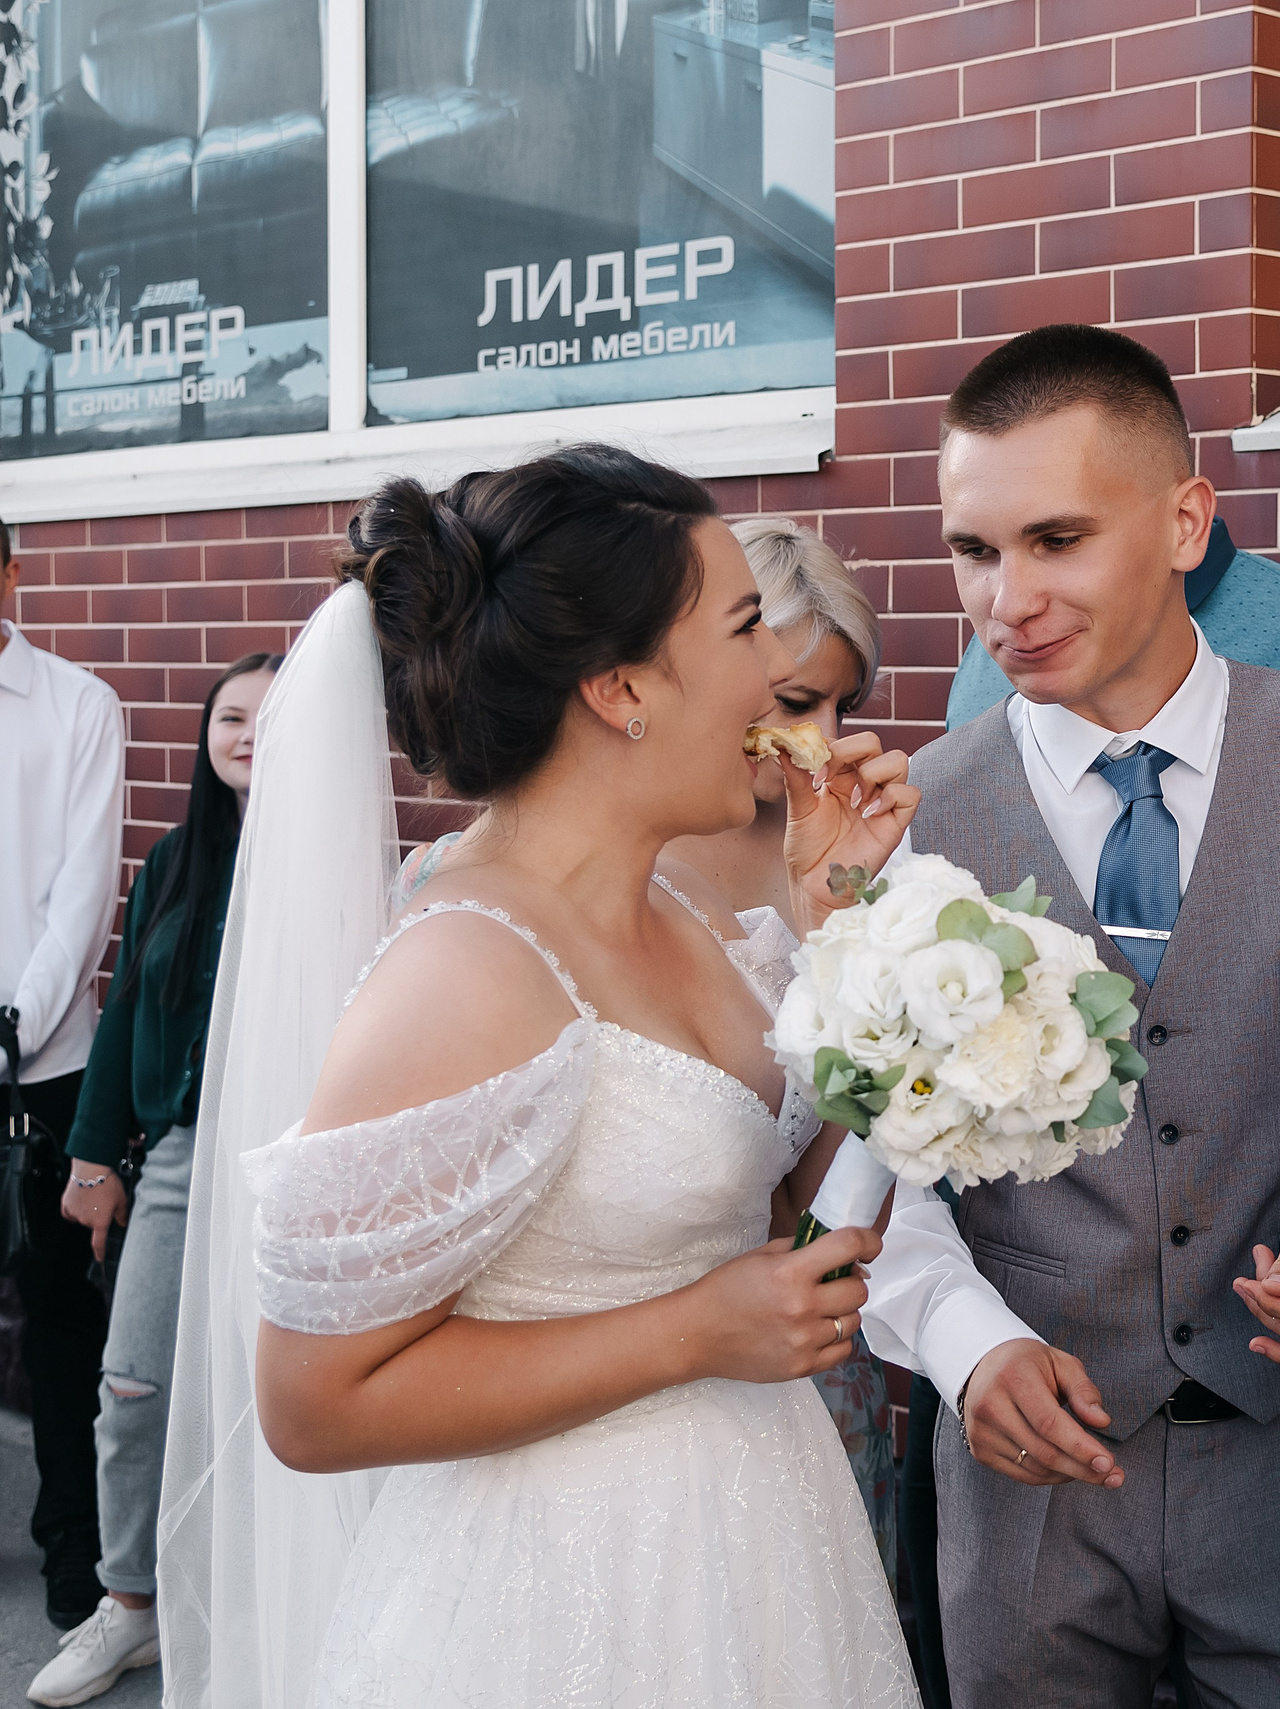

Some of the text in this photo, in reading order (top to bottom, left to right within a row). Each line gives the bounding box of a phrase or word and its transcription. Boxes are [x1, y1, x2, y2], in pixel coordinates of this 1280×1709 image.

[476, 235, 735, 327] ЛИДЕР
[67, 305, 246, 378] ЛИДЕР
[477, 319, 737, 373] салон мебели
[67, 374, 247, 417] салон мебели
